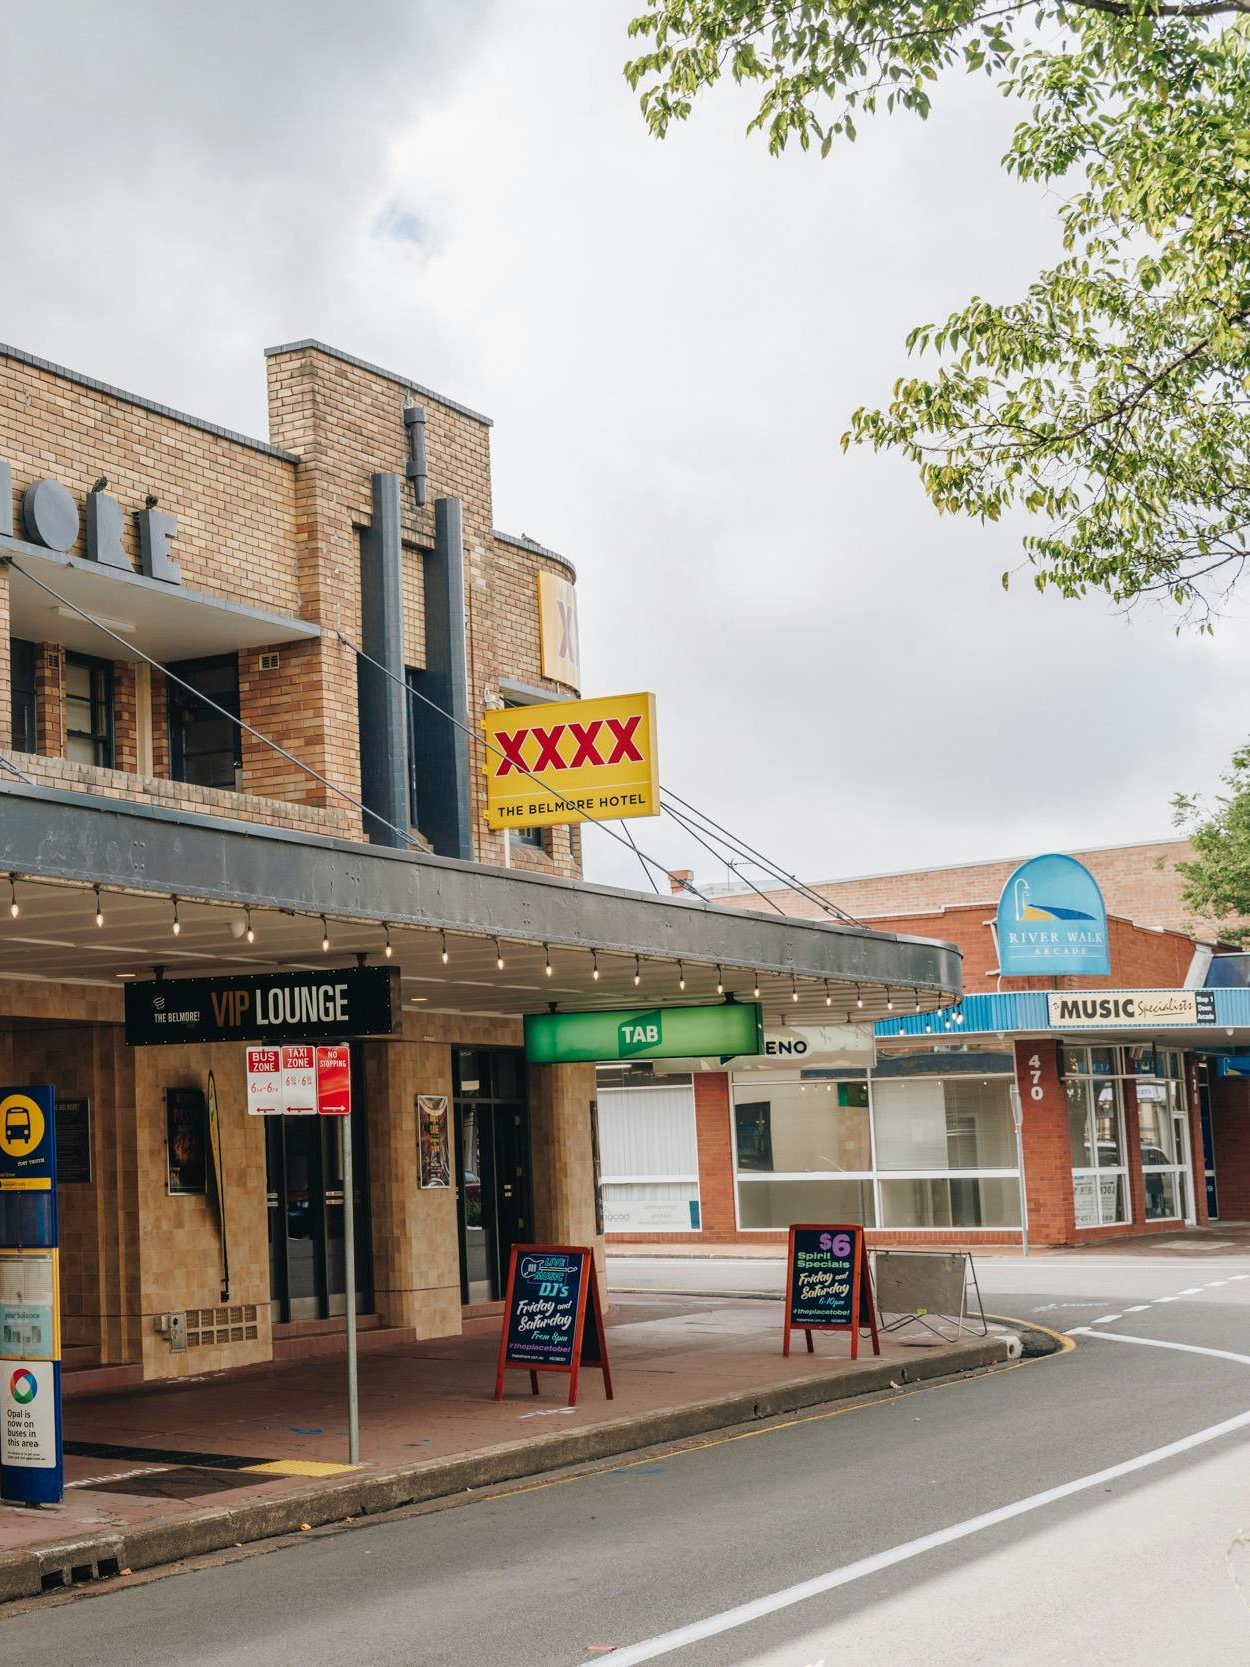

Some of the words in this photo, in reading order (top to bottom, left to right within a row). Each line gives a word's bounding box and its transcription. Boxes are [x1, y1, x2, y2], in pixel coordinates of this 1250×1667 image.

[493, 714, 645, 777] XXXX
[498, 805, 524, 817] THE
[529, 798, 594, 815] BELMORE
[600, 793, 646, 808] HOTEL
[1009, 932, 1059, 944] RIVER
[1067, 932, 1103, 943] WALK
[1035, 947, 1087, 956] ARCADE
[210, 990, 250, 1028] VIP
[256, 984, 349, 1026] LOUNGE
[1060, 999, 1135, 1019] MUSIC
[1137, 997, 1193, 1019] Specialists
[154, 1013, 167, 1024] THE
[168, 1010, 201, 1023] BELMORE!
[621, 1025, 659, 1044] TAB
[288, 1048, 307, 1058] TAXI
[765, 1040, 808, 1055] ENO
[252, 1052, 275, 1061] BUS
[253, 1062, 275, 1072] ZONE
[287, 1058, 309, 1068] ZONE
[320, 1060, 347, 1068] STOPPING
[819, 1232, 851, 1257] $6
[797, 1252, 831, 1260] Spirit
[797, 1260, 850, 1269] Specials
[798, 1271, 834, 1286] Friday
[835, 1271, 849, 1280] and
[538, 1282, 569, 1297] DJ's
[800, 1282, 850, 1300] Saturday
[516, 1299, 556, 1317] Friday
[557, 1300, 573, 1310] and
[793, 1308, 850, 1316] #theplacetobe!
[518, 1313, 573, 1332] Saturday
[530, 1331, 550, 1341] From
[551, 1331, 568, 1344] 8pm
[509, 1342, 572, 1353] #theplacetobe!
[6, 1409, 23, 1419] Opal
[24, 1410, 31, 1419] is
[7, 1420, 22, 1428] now
[7, 1429, 27, 1438] buses
[28, 1430, 36, 1438] in
[7, 1438, 20, 1447] this
[21, 1440, 39, 1448] area
